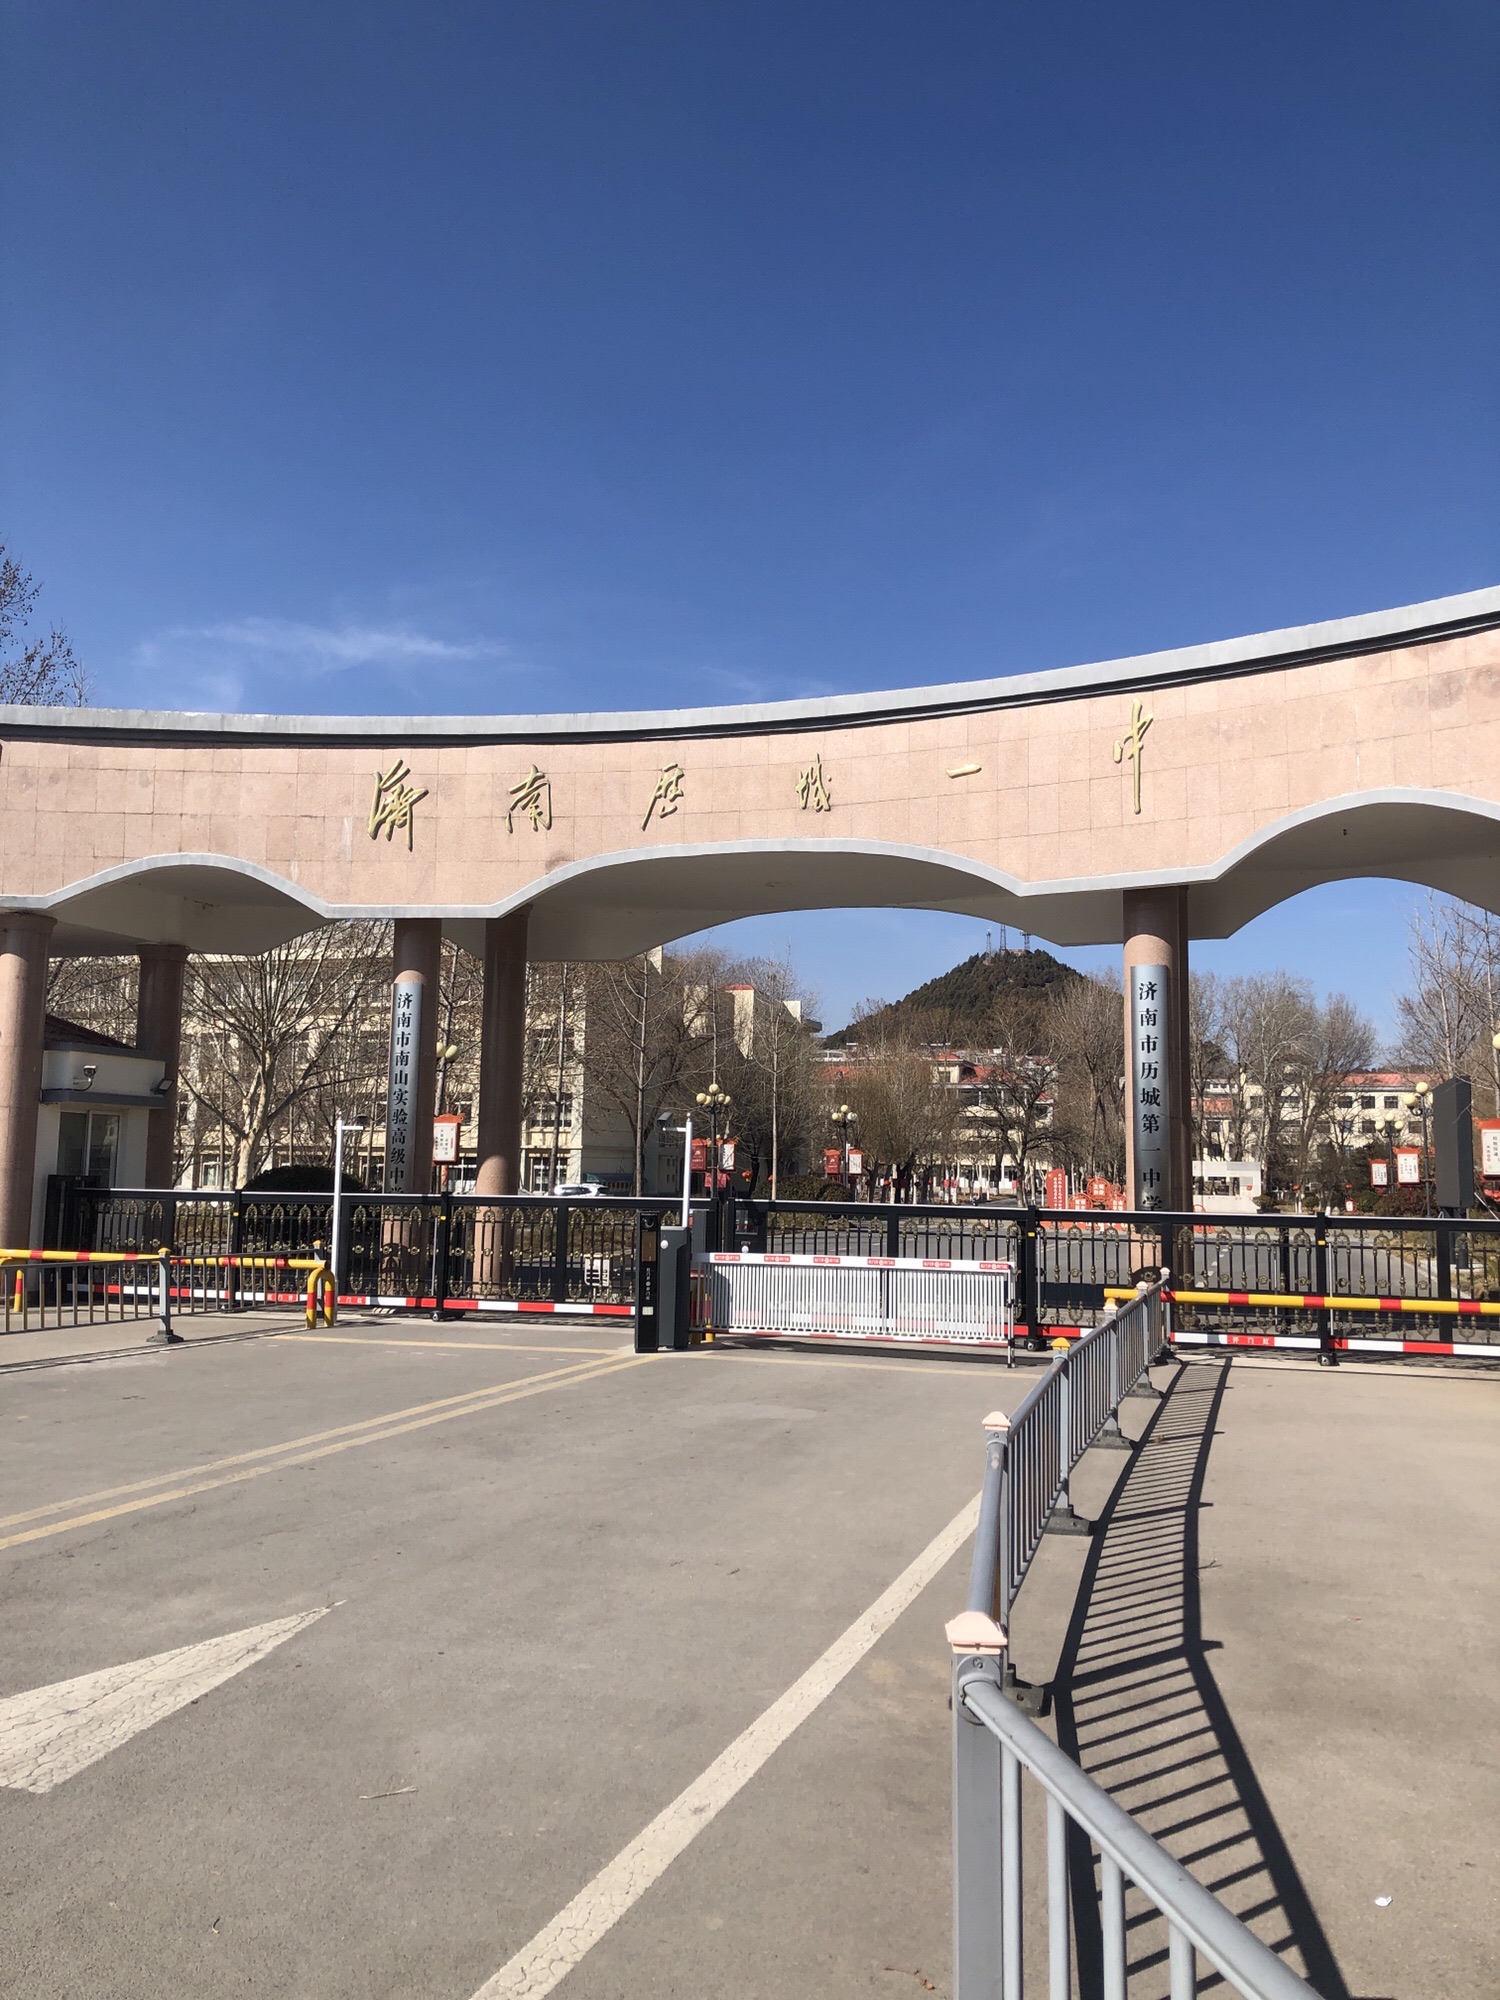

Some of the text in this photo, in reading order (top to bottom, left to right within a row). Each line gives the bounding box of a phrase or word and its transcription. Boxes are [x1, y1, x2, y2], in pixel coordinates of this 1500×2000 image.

[1138, 981, 1163, 1211] 济南市历城第一中学
